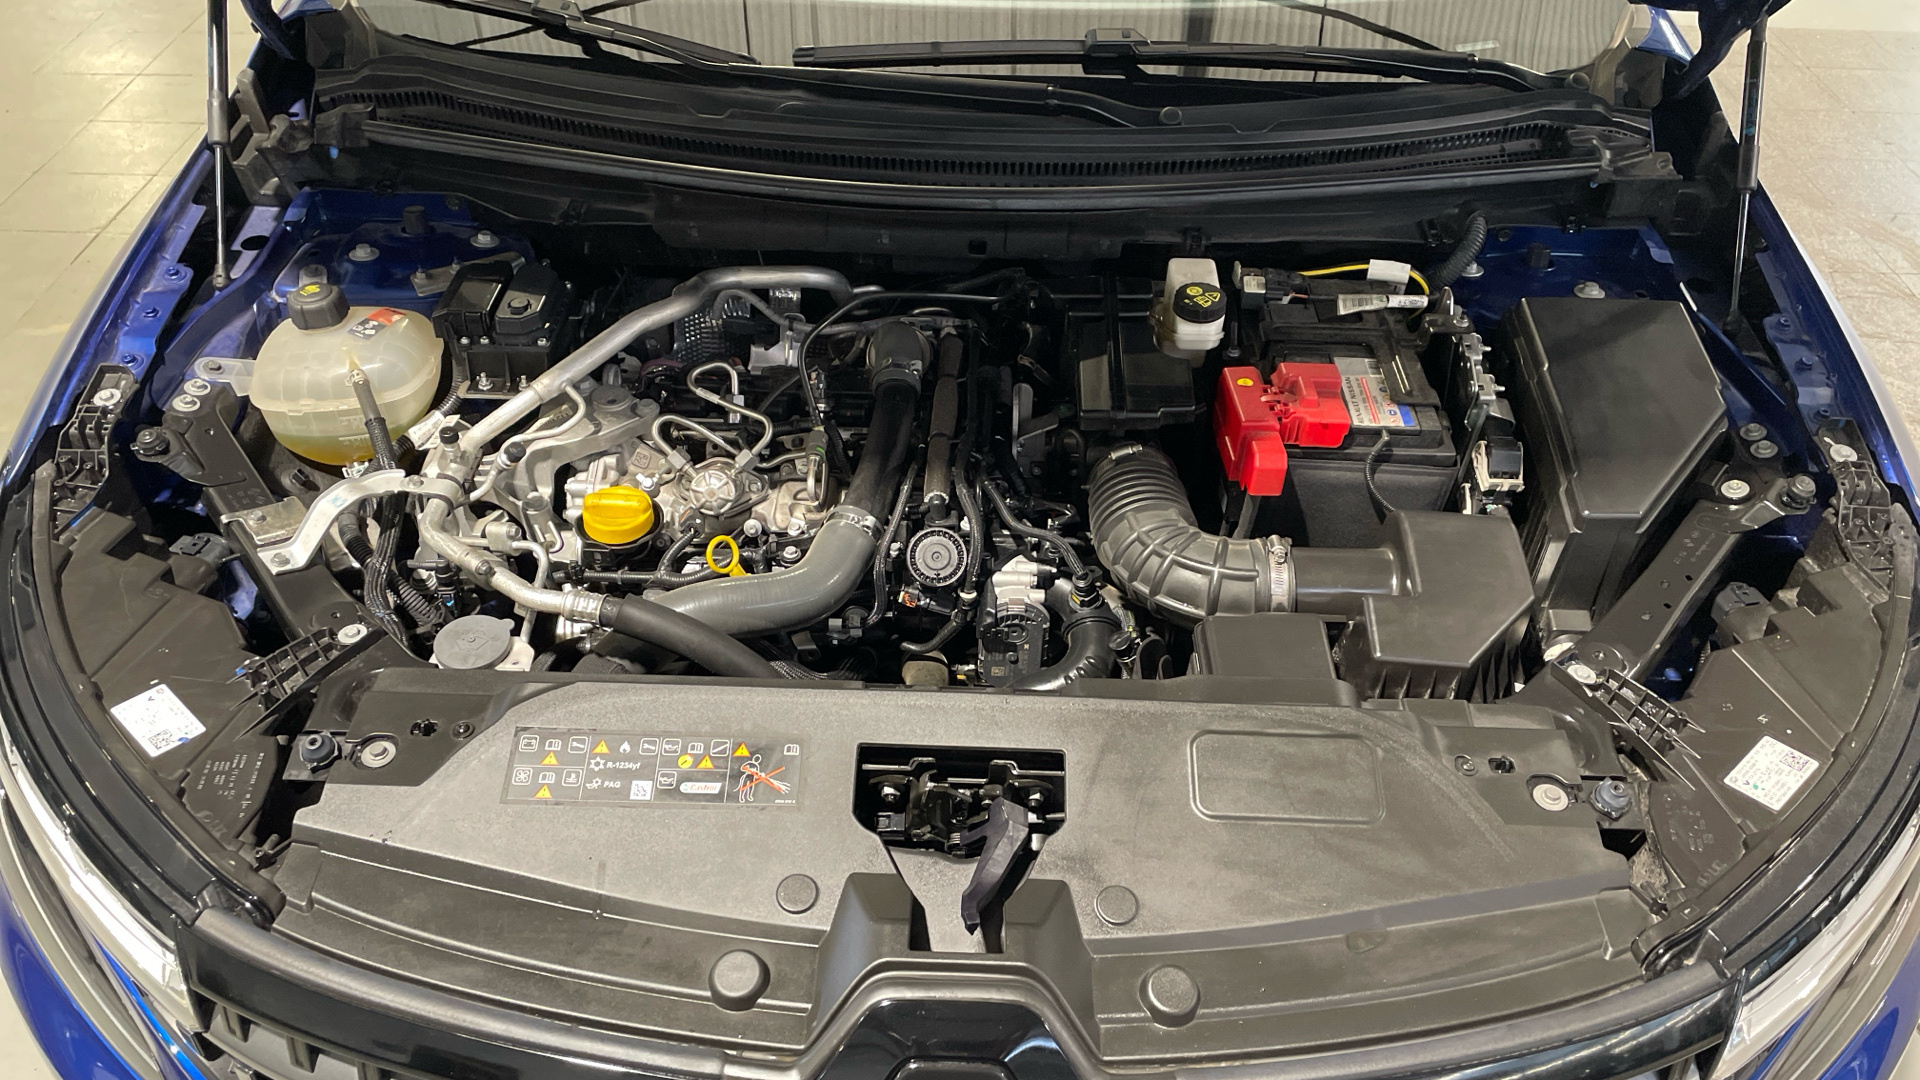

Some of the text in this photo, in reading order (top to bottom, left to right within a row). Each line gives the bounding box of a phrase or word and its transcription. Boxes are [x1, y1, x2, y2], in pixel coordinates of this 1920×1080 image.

[1344, 376, 1356, 400] NISSAN
[606, 761, 641, 771] R-1234yf
[603, 781, 621, 789] PAG
[689, 783, 718, 792] Castrol
